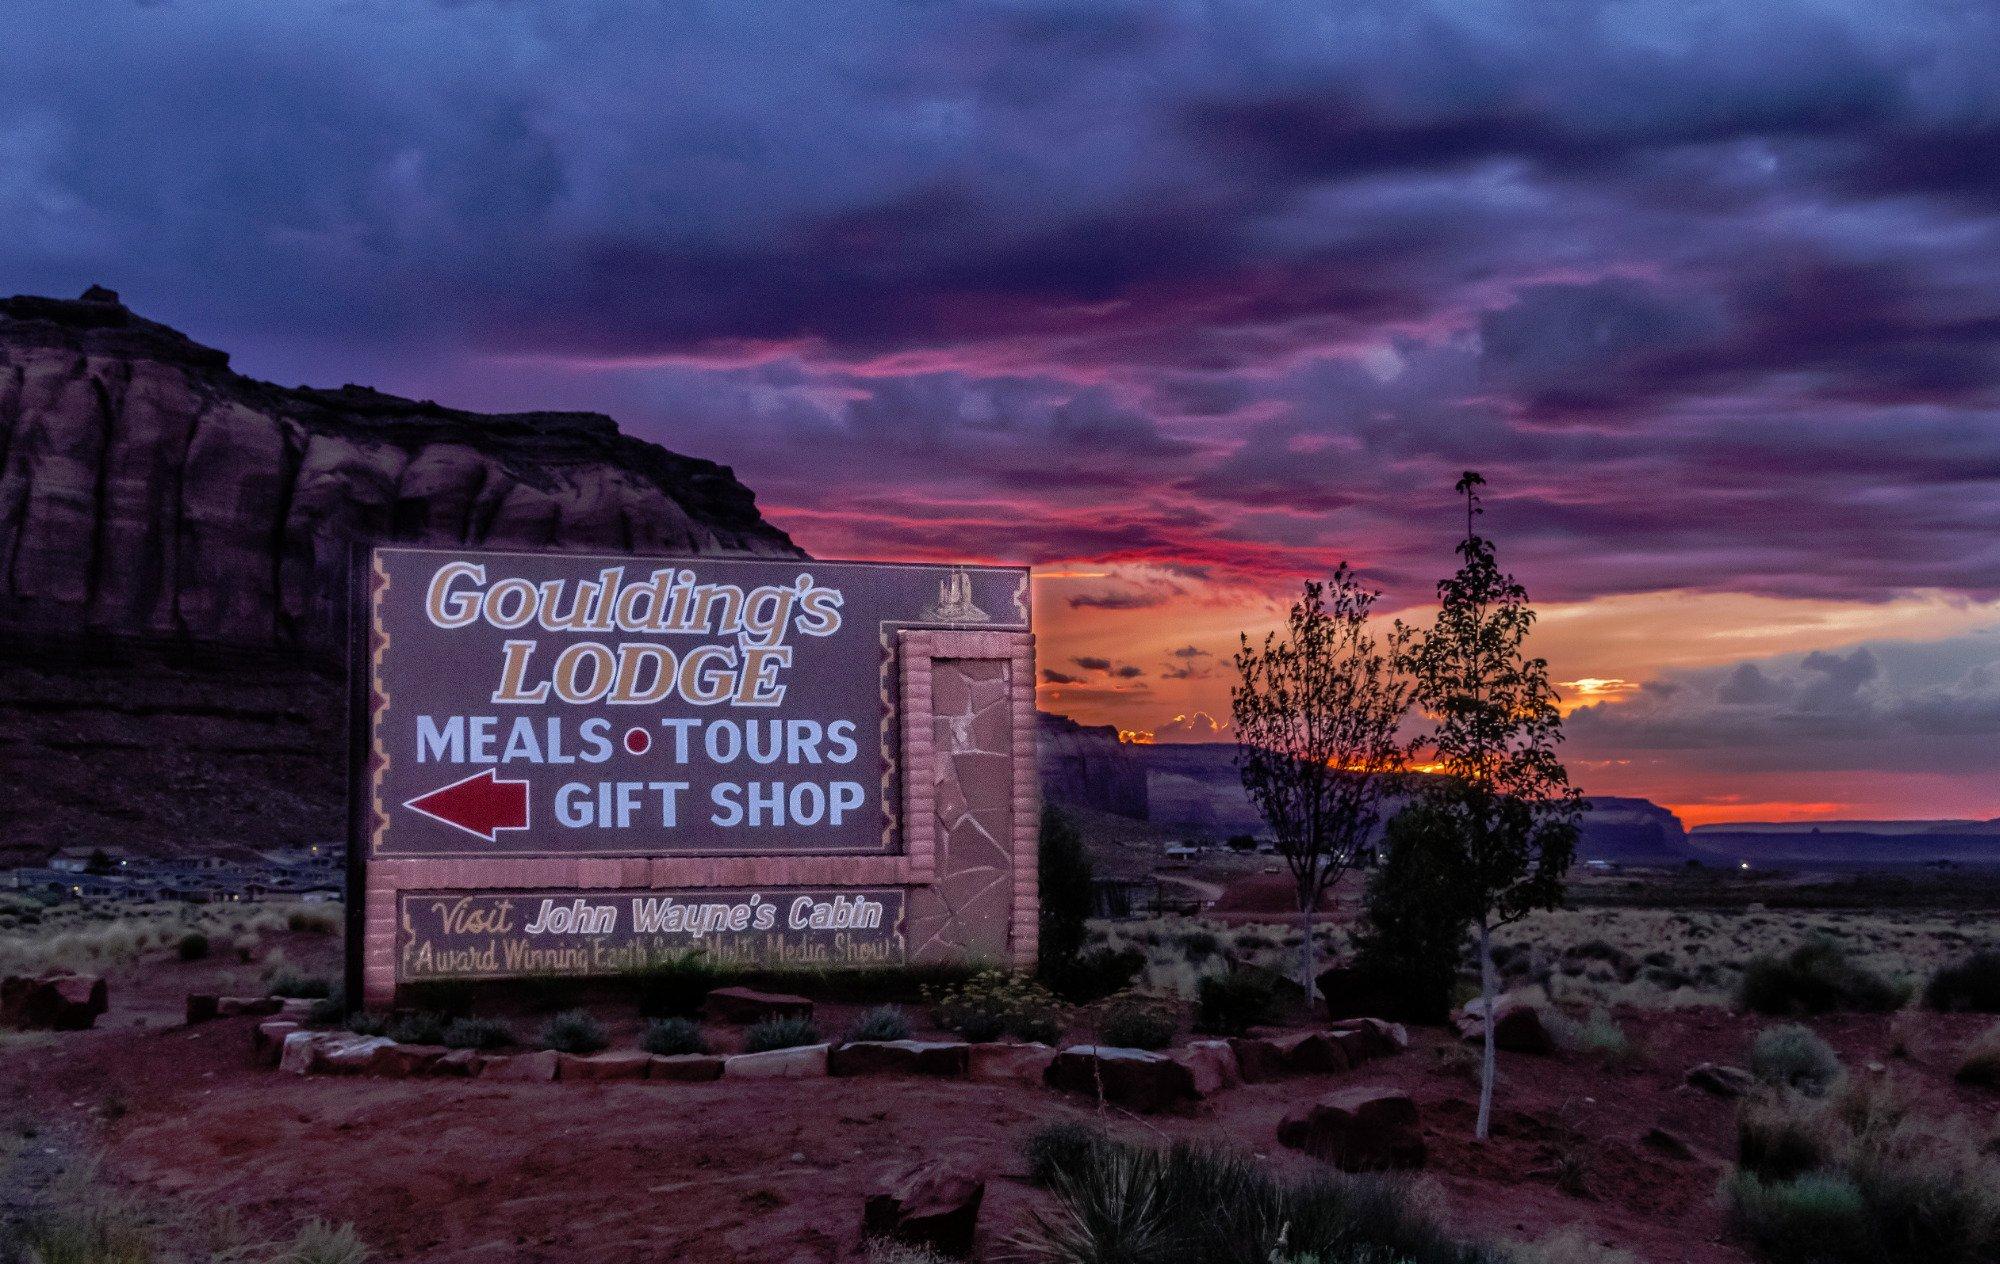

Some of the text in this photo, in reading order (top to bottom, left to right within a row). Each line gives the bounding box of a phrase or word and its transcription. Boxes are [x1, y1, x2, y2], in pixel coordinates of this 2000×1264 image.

[425, 561, 844, 647] Goulding's
[491, 640, 792, 707] LODGE
[416, 715, 858, 764] MEALS TOURS
[554, 782, 865, 828] GIFT SHOP
[431, 894, 883, 938] Visit John Wayne's Cabin
[415, 940, 499, 972] Award
[503, 938, 588, 975] Winning
[835, 931, 890, 962] Show
